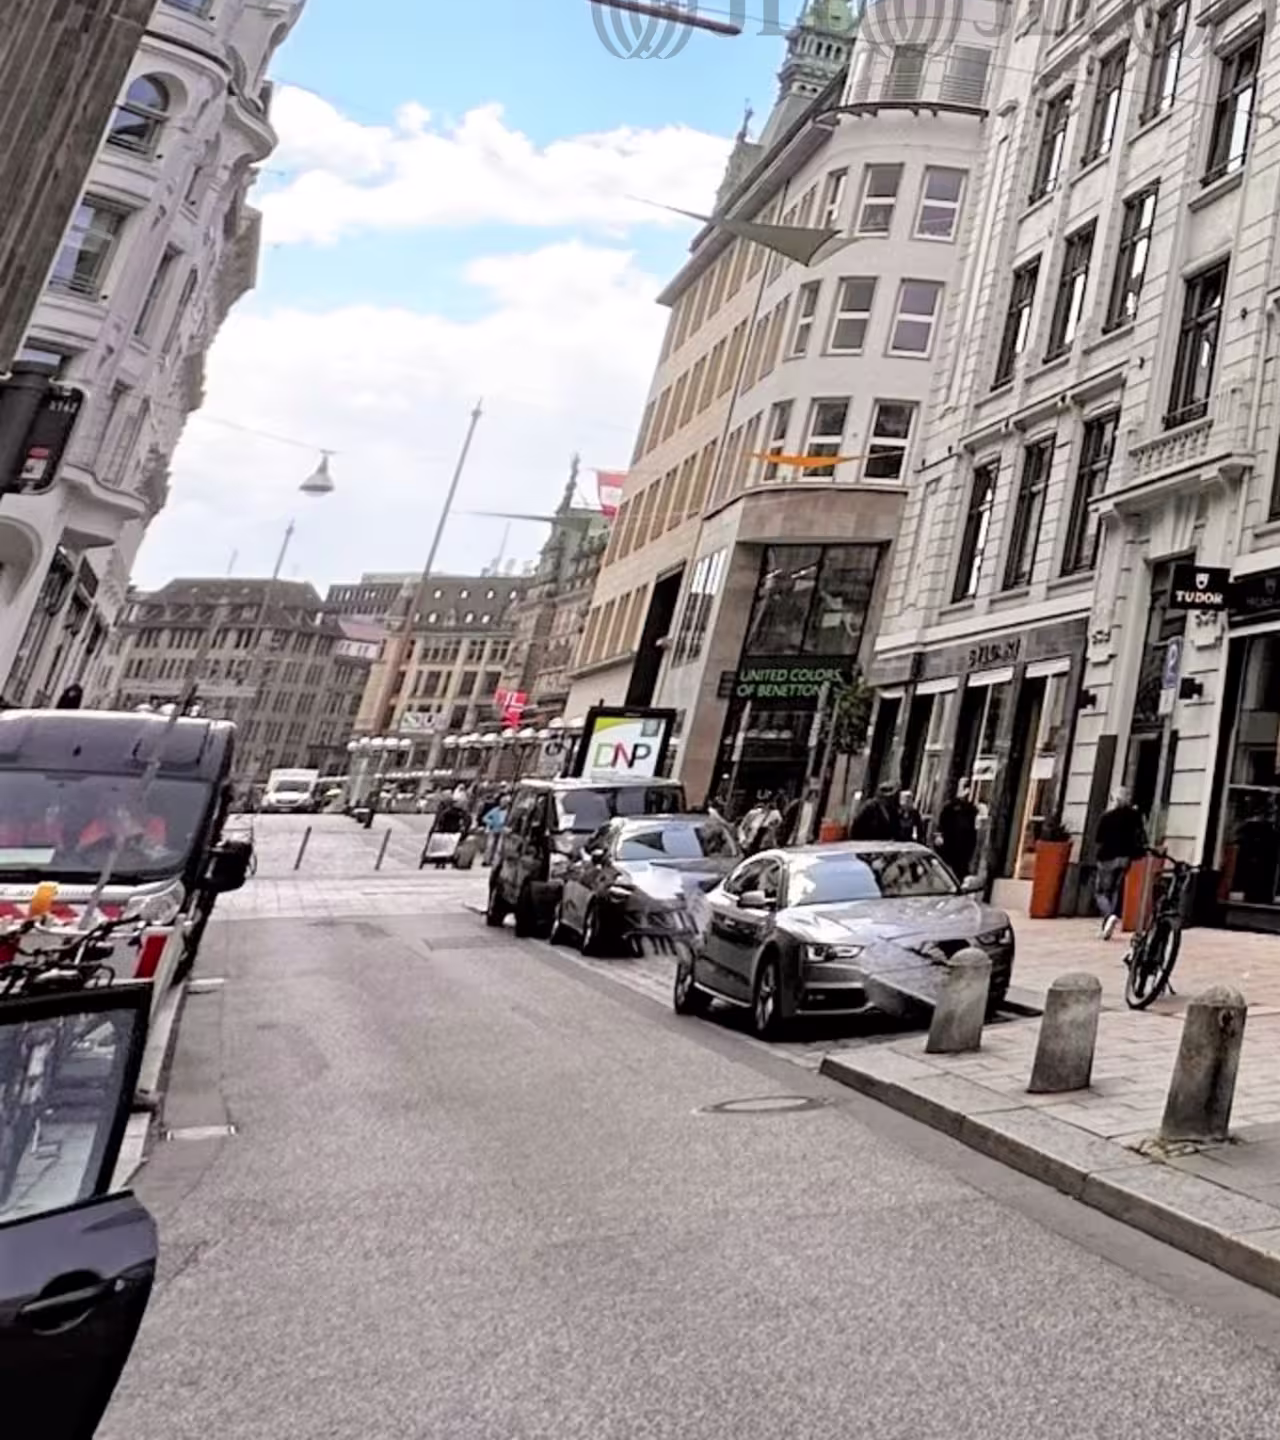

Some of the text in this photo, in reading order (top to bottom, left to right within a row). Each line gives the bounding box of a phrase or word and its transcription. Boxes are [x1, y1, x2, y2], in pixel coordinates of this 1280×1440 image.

[1175, 589, 1224, 604] TUDOR
[740, 668, 844, 682] UNITED COLORS
[736, 684, 756, 698] OF
